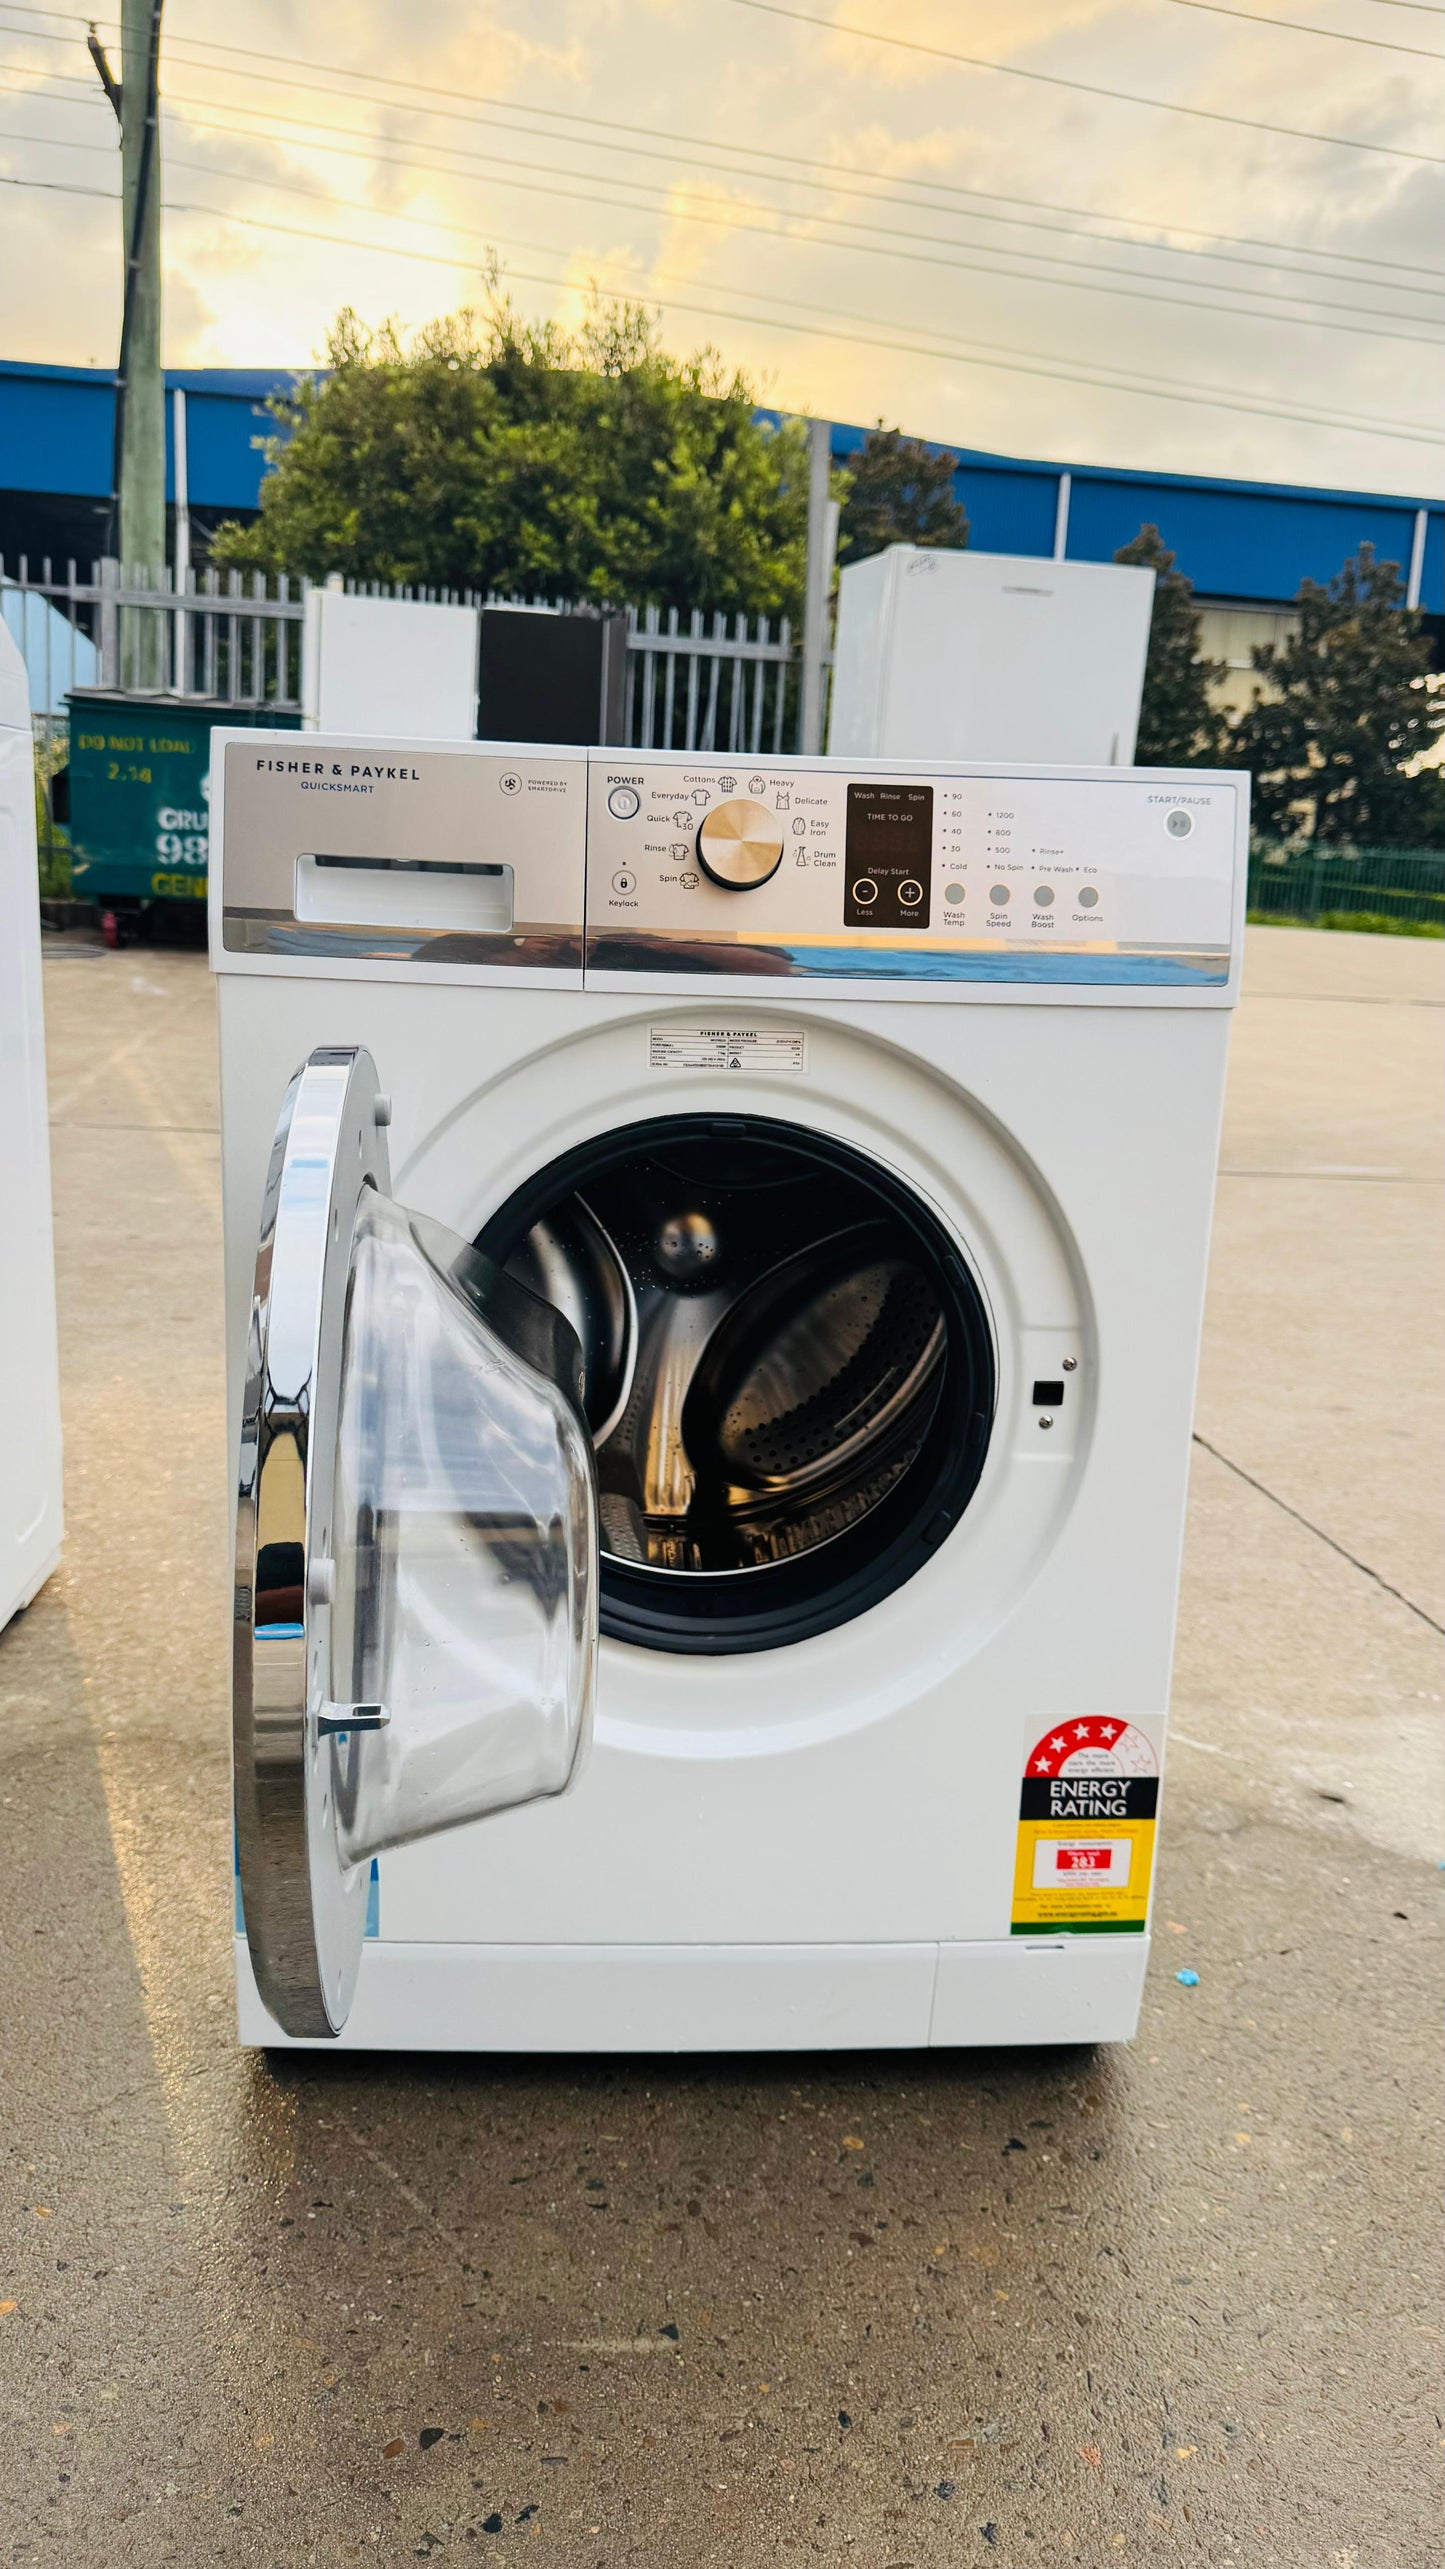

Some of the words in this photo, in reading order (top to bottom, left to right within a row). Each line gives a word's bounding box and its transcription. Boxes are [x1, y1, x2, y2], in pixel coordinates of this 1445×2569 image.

[109, 736, 143, 752] NOT
[256, 759, 324, 775] FISHER
[332, 764, 343, 776] &
[351, 765, 420, 781] PAYKEL
[607, 776, 645, 785] POWER
[683, 775, 716, 784] Cottons
[769, 779, 795, 788] Heavy
[300, 781, 375, 794] QUICKSMART
[651, 791, 689, 801] Everyday
[854, 791, 875, 800] Wash
[880, 792, 901, 800] Rinse
[908, 793, 925, 801] Spin
[1147, 795, 1213, 806] START/PAUSE
[794, 797, 828, 805] Delicate
[646, 814, 670, 823] Quick
[867, 813, 886, 821] TIME
[900, 814, 913, 822] GO
[682, 823, 694, 831] 30
[810, 820, 829, 829] Easy
[156, 833, 209, 865] 98
[644, 844, 667, 852] Rinse
[813, 851, 836, 859] Drum
[813, 859, 836, 867] Clean
[867, 867, 889, 876] Delay
[1007, 864, 1024, 872] Spin
[659, 875, 678, 883] Spin
[608, 899, 639, 908] Keylock
[856, 908, 873, 916] Less
[900, 909, 919, 917] More
[990, 913, 1008, 921] Spin
[1072, 914, 1103, 922] Options
[943, 919, 965, 927] Temp
[986, 920, 1012, 928] Speed
[1031, 921, 1054, 929] Boost
[1050, 1780, 1131, 1798] ENERGY
[1050, 1799, 1127, 1817] RATING
[1071, 1856, 1096, 1869] 283
